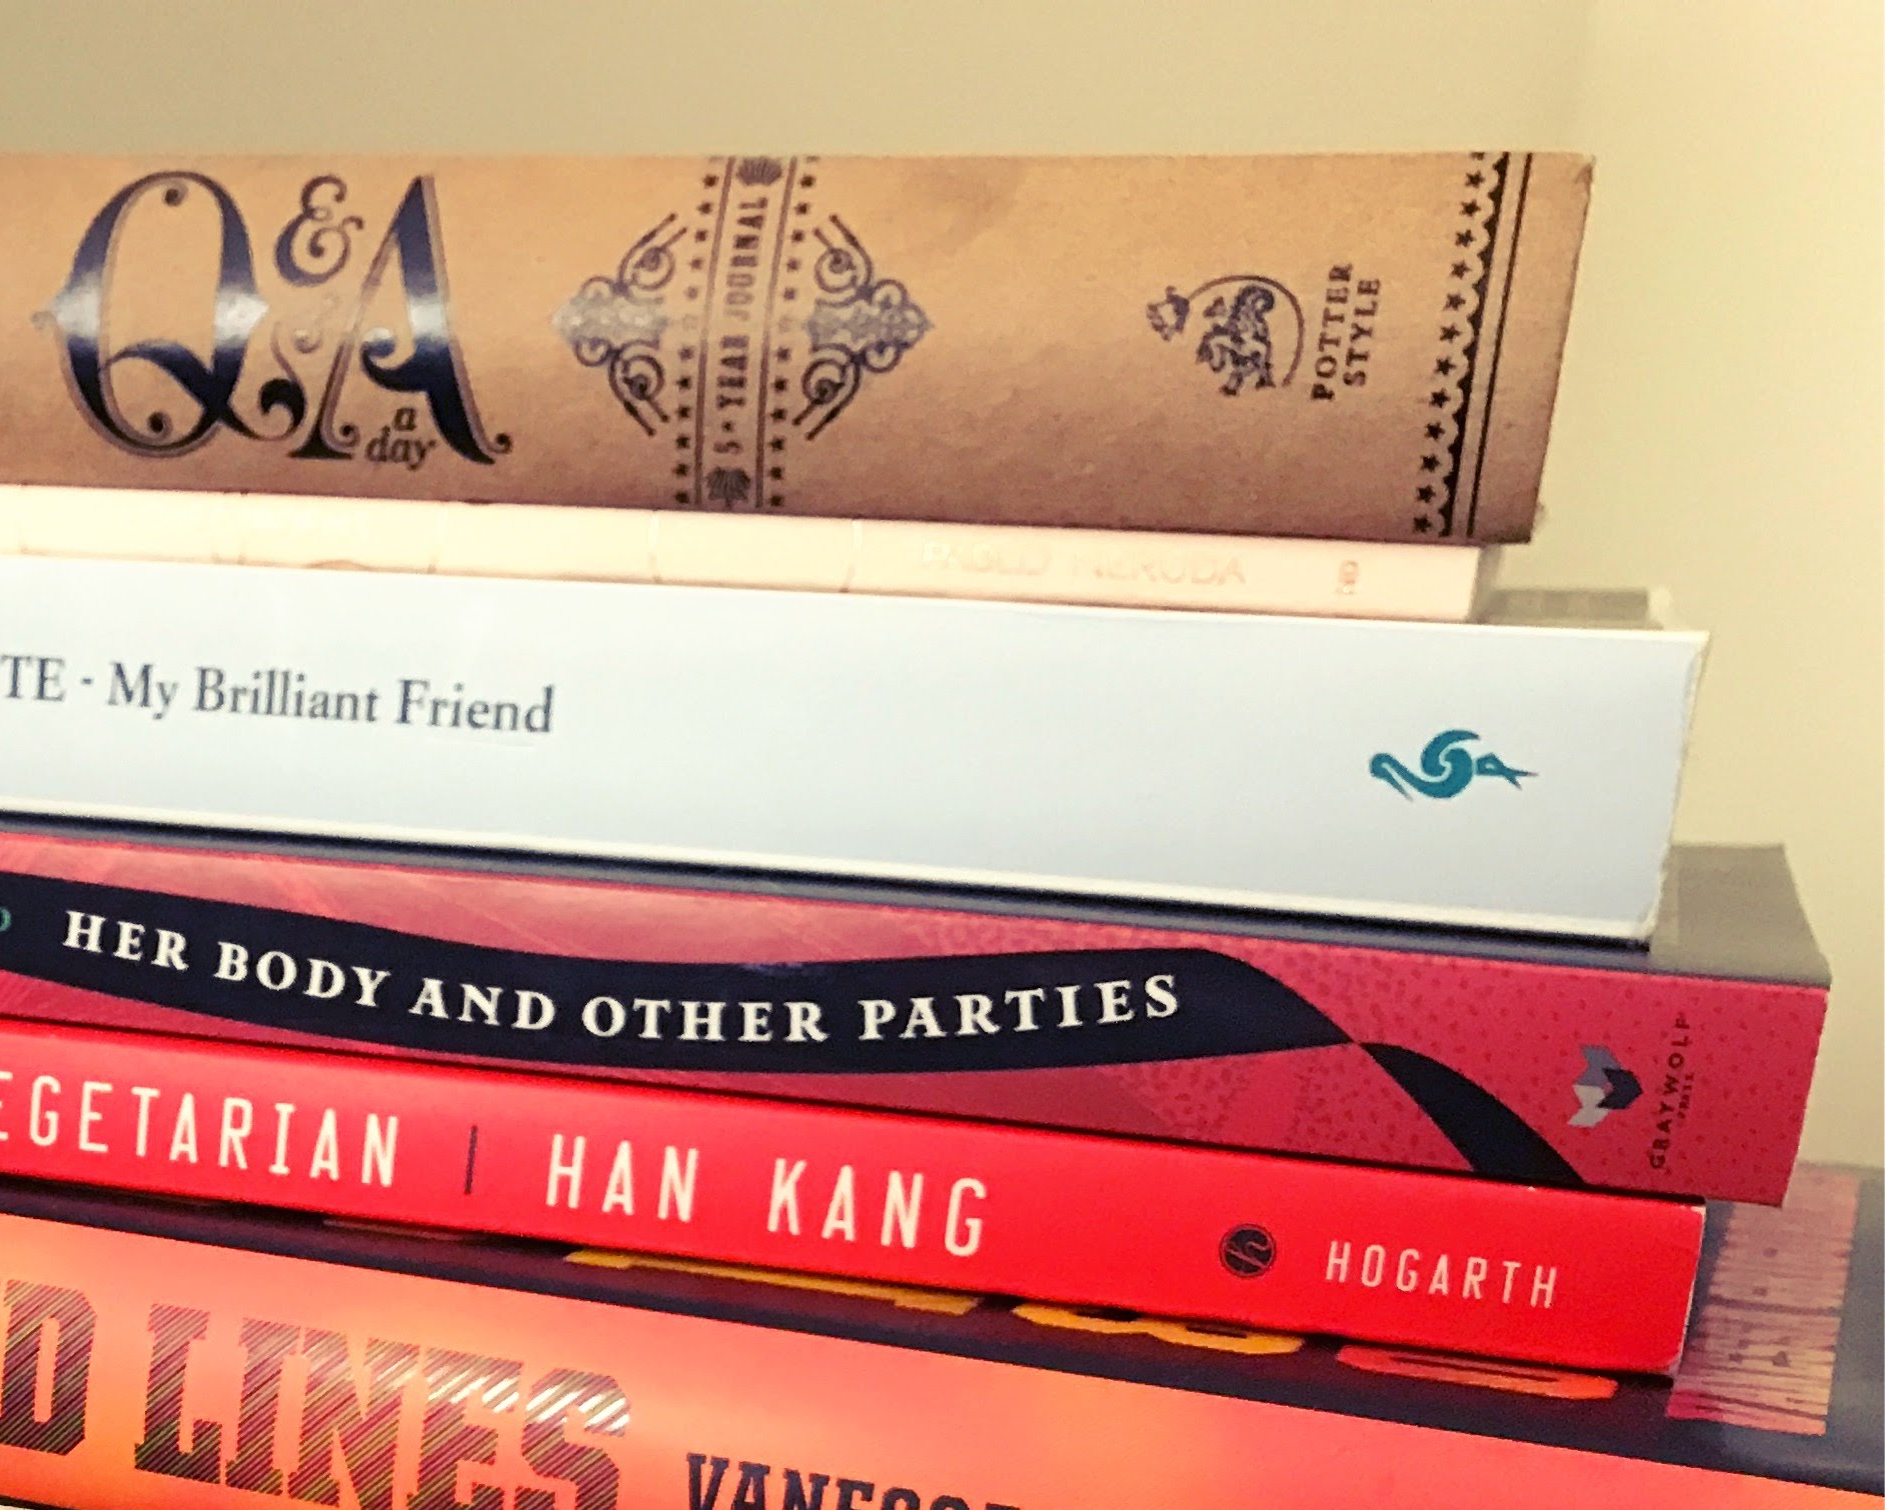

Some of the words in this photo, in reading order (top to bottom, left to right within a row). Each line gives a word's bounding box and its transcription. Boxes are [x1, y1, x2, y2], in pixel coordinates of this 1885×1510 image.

[724, 197, 769, 321] JOURNAL
[1311, 262, 1354, 401] POTTER
[1342, 278, 1382, 388] STYLE
[365, 434, 438, 471] day
[107, 660, 179, 721] My
[194, 667, 379, 724] Brilliant
[395, 680, 556, 735] Friend
[60, 909, 191, 971] HER
[214, 940, 393, 1008] BODY
[407, 979, 556, 1032] AND
[581, 995, 831, 1043] OTHER
[858, 974, 1181, 1041] PARTIES
[1648, 1011, 1693, 1170] GRAYWOLF
[545, 1133, 700, 1222] HAN
[767, 1158, 988, 1258] KANG
[1326, 1239, 1557, 1309] HOGARTH
